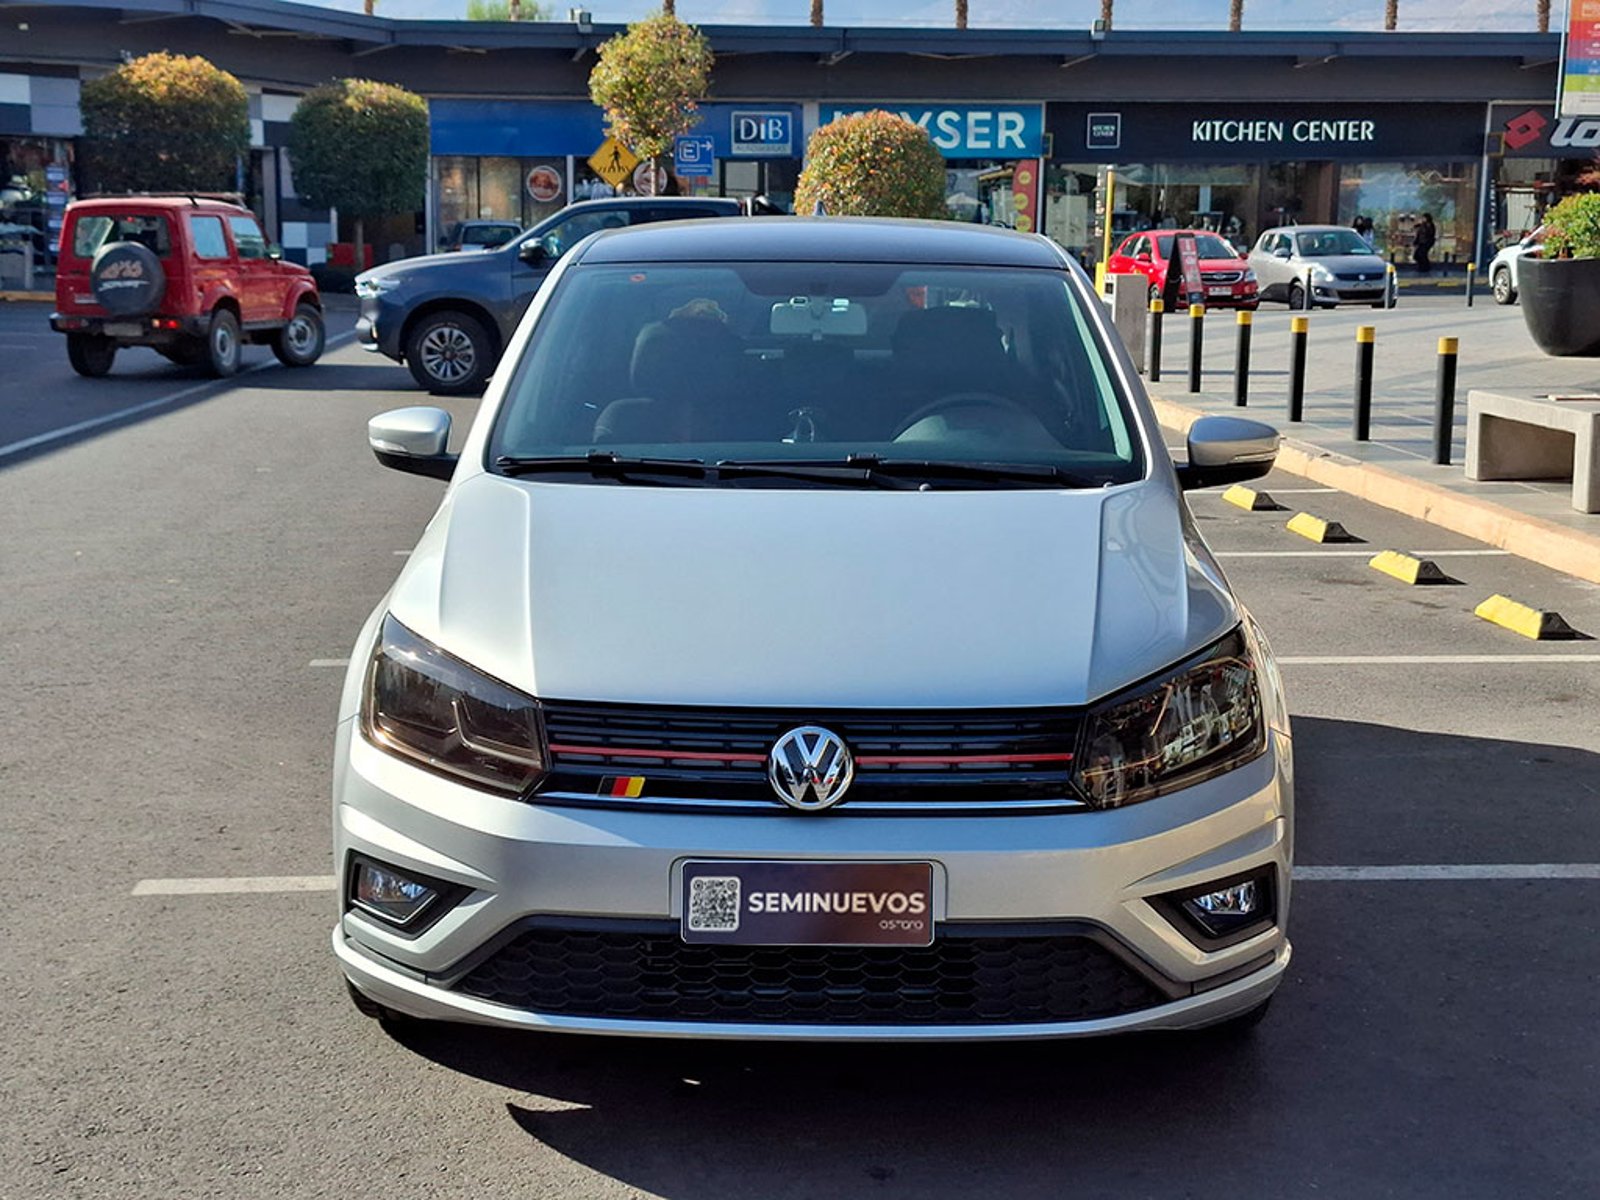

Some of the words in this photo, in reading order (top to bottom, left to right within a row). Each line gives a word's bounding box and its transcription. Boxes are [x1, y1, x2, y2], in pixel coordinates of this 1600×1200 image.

[1192, 120, 1284, 142] KITCHEN
[1292, 120, 1375, 142] CENTER
[748, 892, 926, 914] SEMINUEVOS
